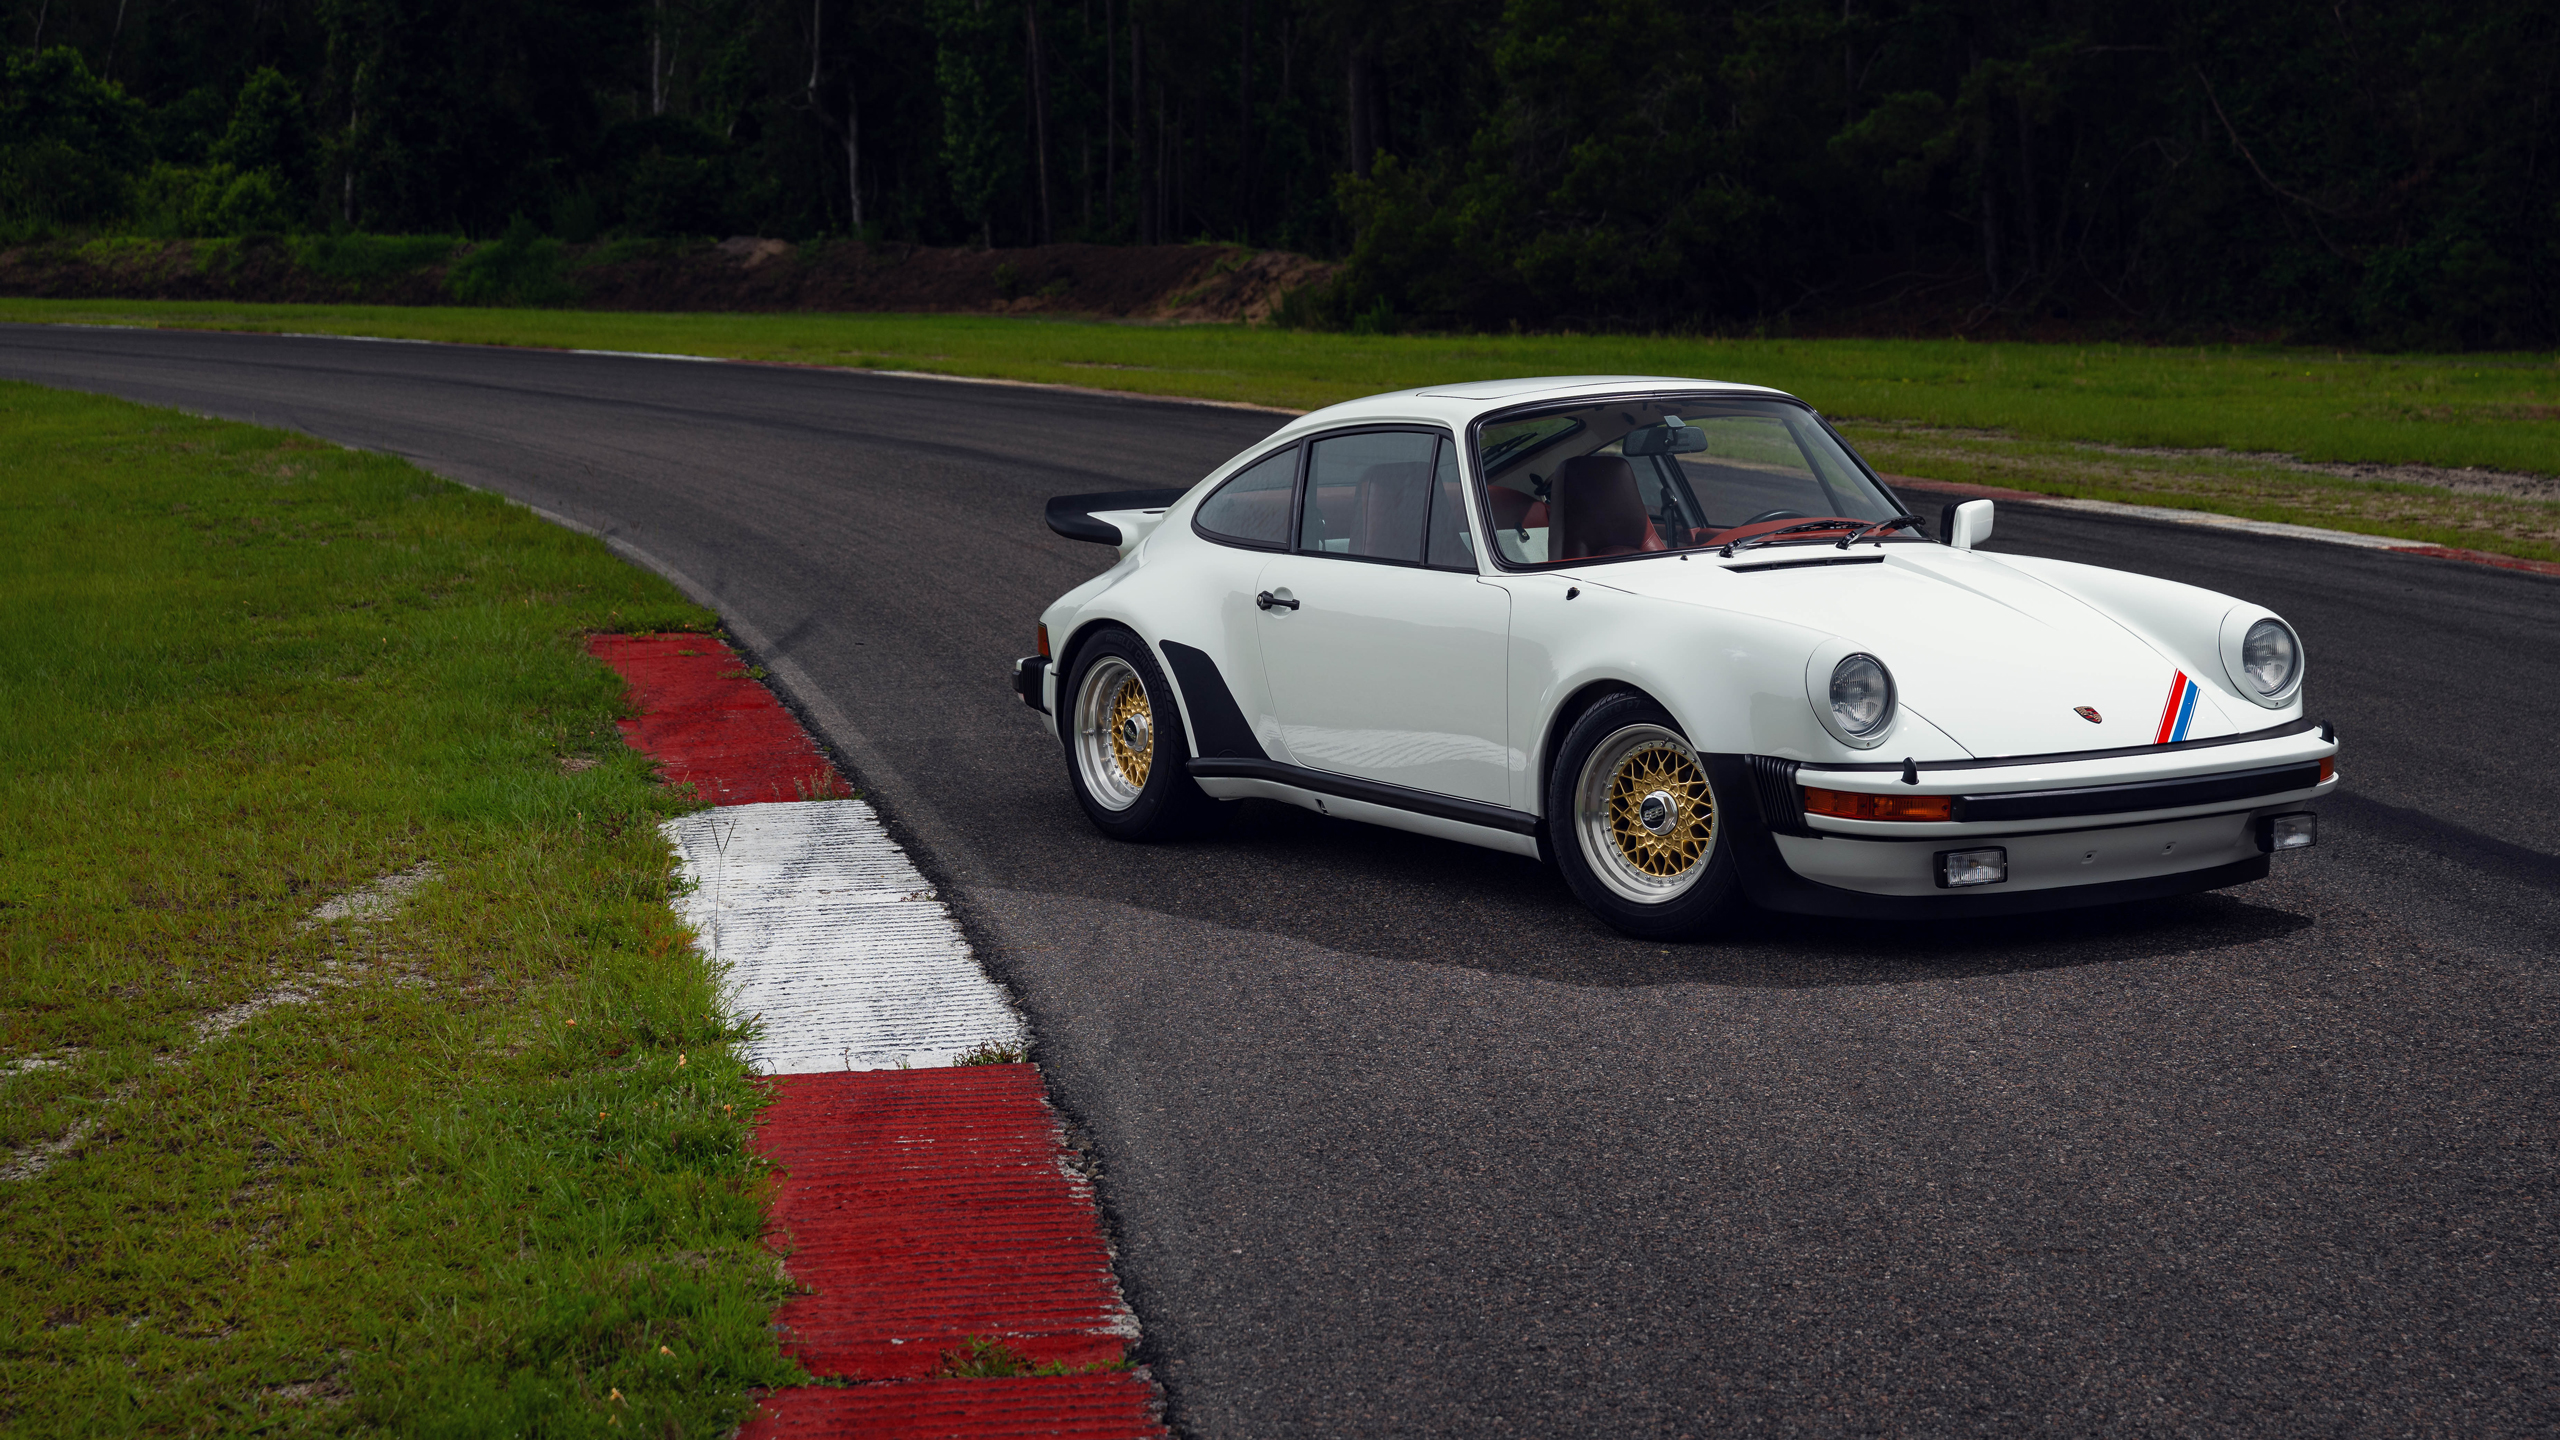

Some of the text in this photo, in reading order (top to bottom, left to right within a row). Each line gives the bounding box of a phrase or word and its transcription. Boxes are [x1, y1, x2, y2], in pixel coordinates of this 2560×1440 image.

[1105, 633, 1135, 652] PIRELLI
[1134, 649, 1164, 717] CINTURATO
[1626, 699, 1641, 710] P7
[1643, 806, 1664, 821] BBS
